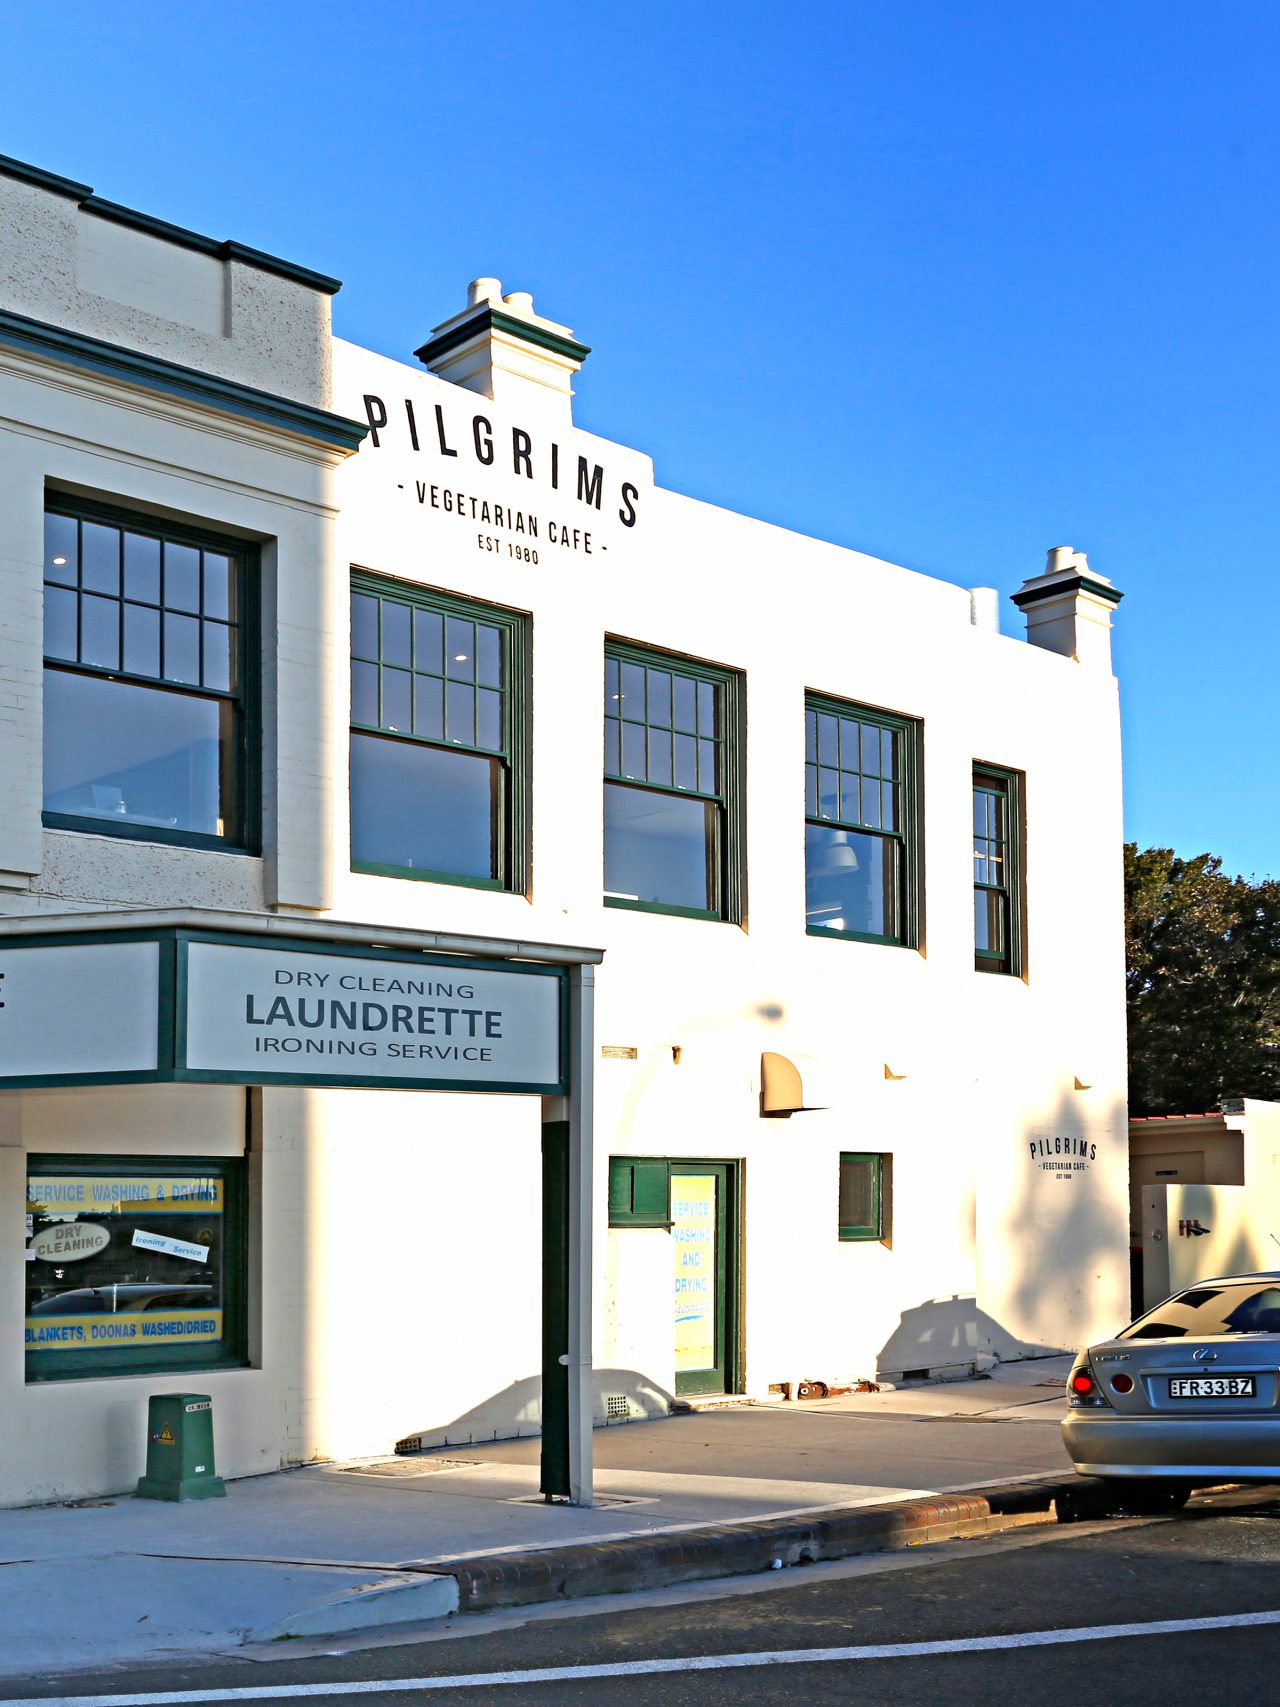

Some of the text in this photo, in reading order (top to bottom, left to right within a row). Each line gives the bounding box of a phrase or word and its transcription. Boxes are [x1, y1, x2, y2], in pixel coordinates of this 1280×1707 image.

[363, 394, 639, 528] PILGRIMS
[415, 480, 593, 555] VEGETARIAN CAFE
[478, 534, 539, 565] EST 1980
[274, 970, 475, 999] DRY CLEANING
[246, 994, 503, 1039] LAUNDRETTE
[254, 1037, 493, 1062] IRONING SERVICE
[1029, 1137, 1097, 1160] PILGRIMS
[1042, 1162, 1086, 1171] VEGETARIAN CAFE
[28, 1184, 218, 1202] SERVICE WASHING & DRYING
[673, 1202, 709, 1216] SERVICE
[55, 1225, 83, 1240] DRY
[37, 1235, 104, 1256] CLEANING
[135, 1236, 203, 1257] Ironing Service
[682, 1252, 701, 1267] AND
[674, 1278, 707, 1293] DRYING
[25, 1319, 217, 1343] BLANKETS, DOONAS WASHED/DRIED
